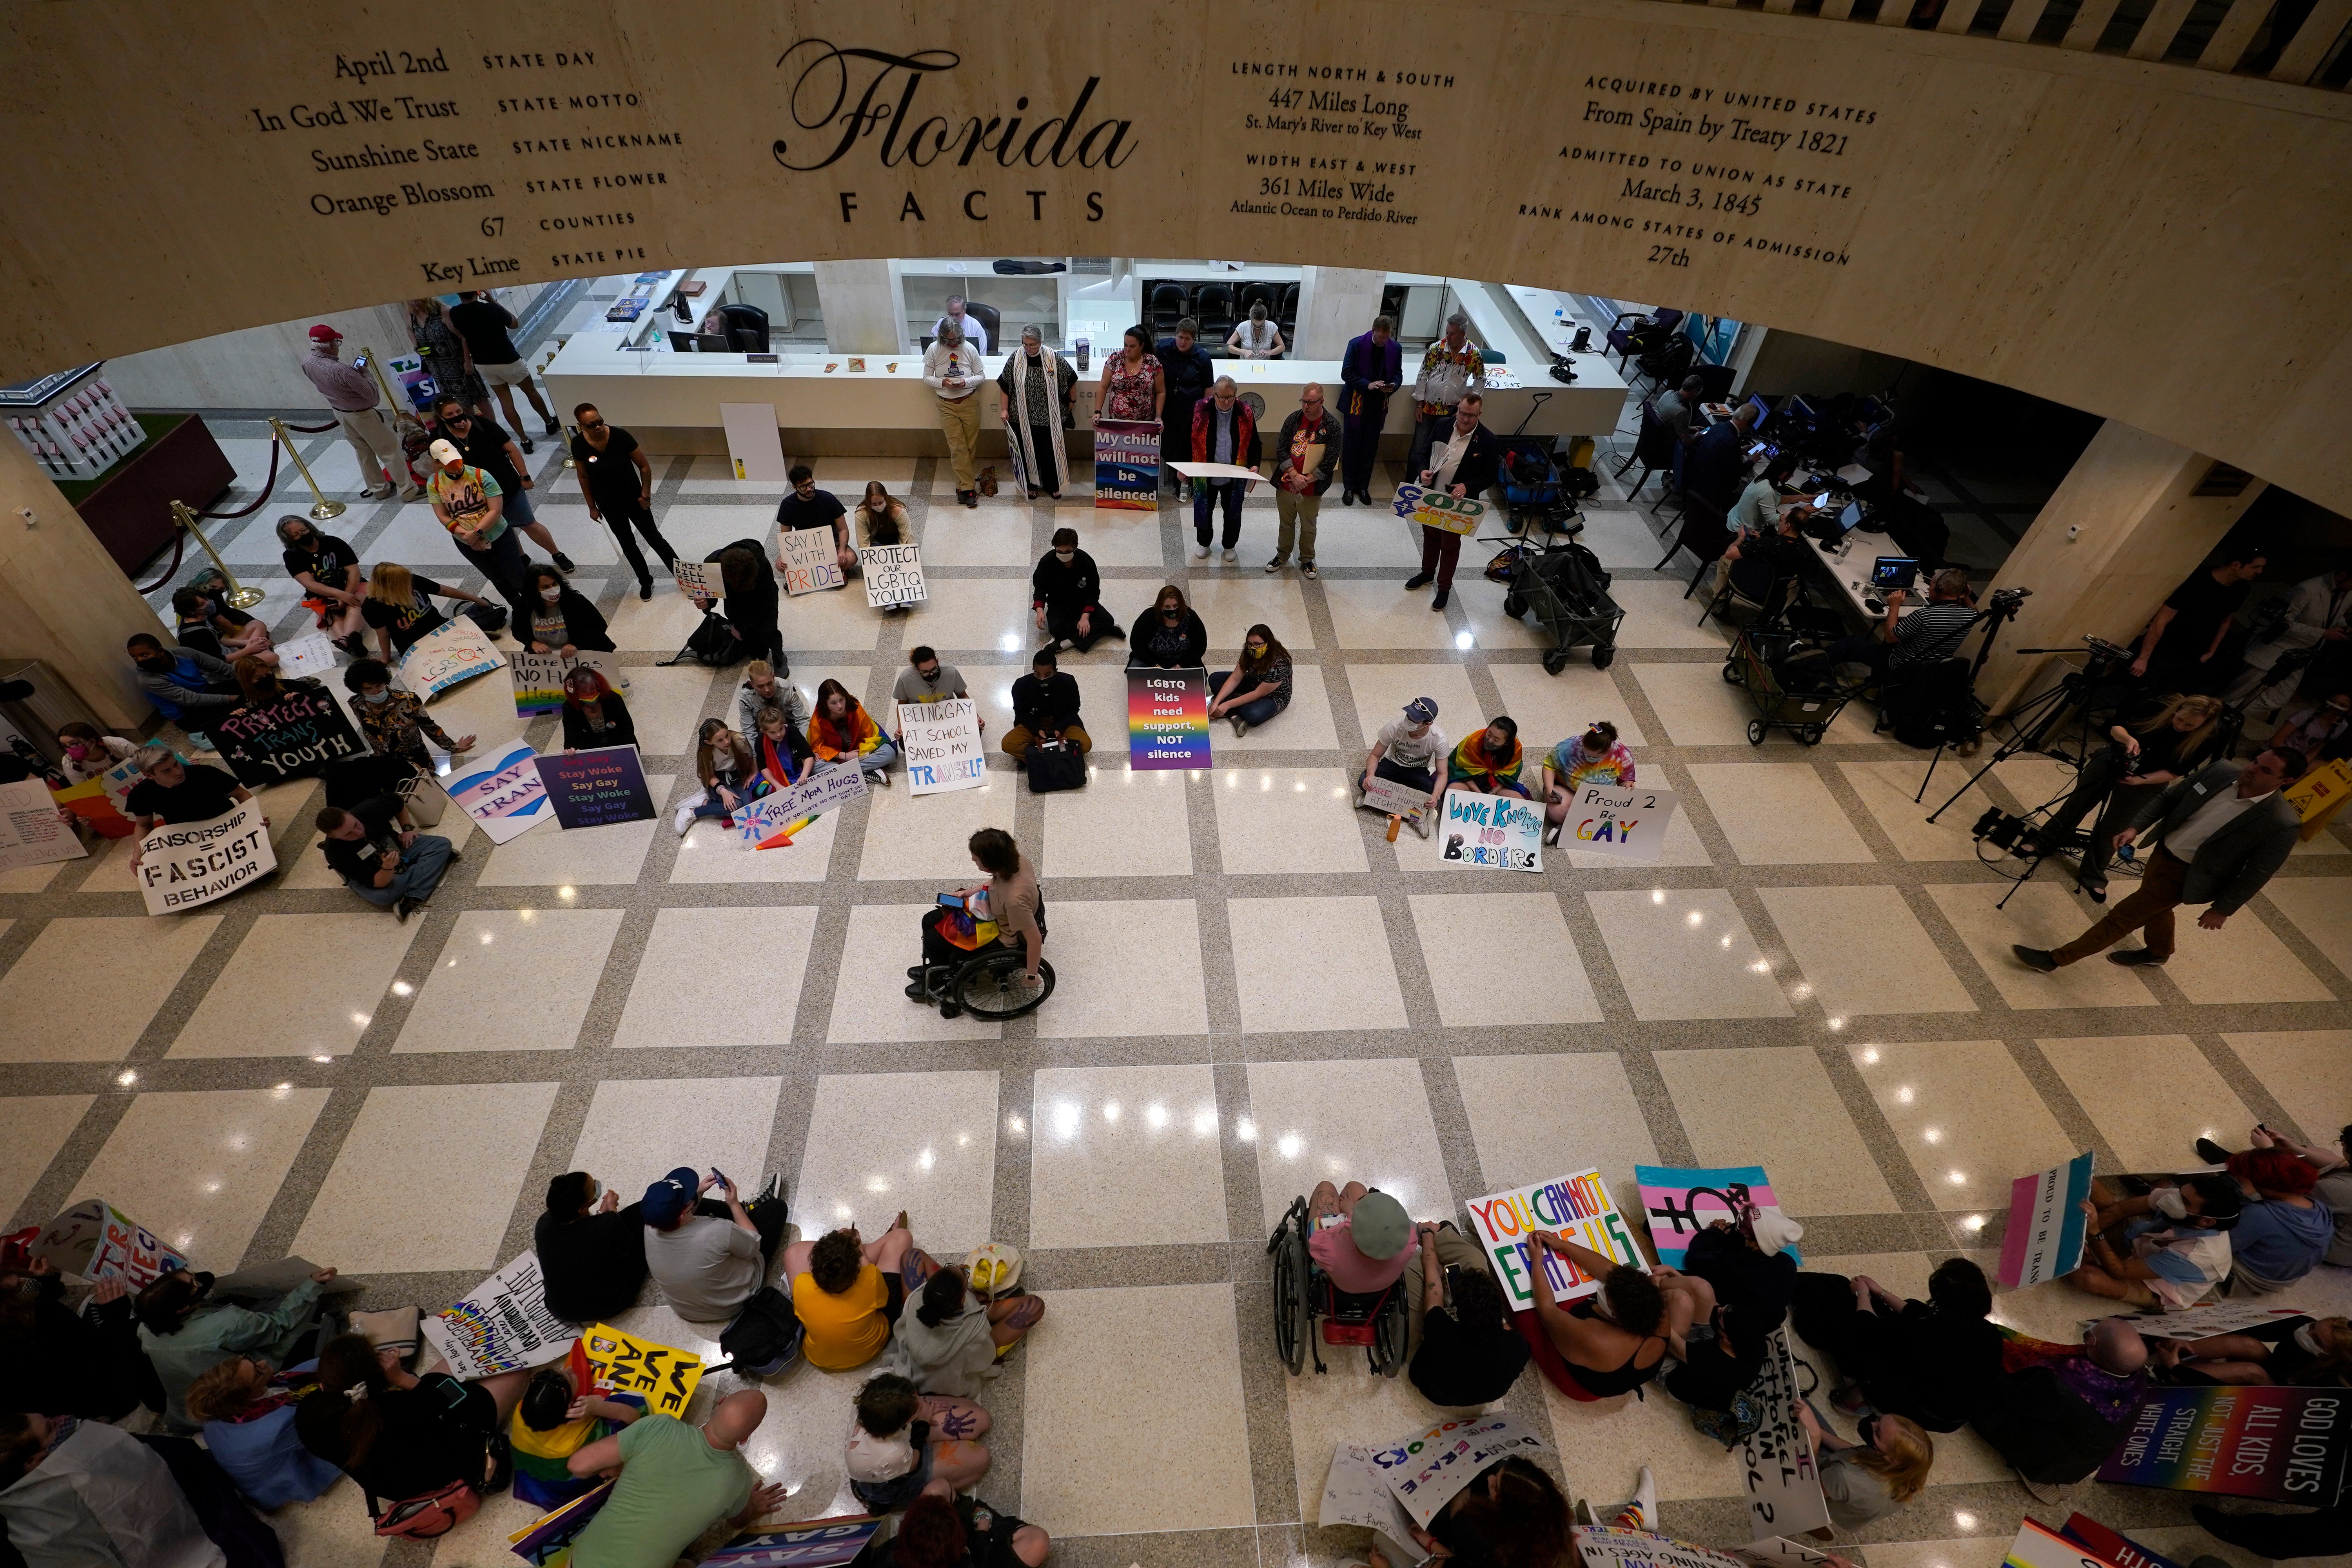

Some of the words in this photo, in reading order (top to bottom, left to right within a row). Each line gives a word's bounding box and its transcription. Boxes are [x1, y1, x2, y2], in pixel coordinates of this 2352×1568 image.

[336, 50, 396, 86] April
[402, 47, 450, 73] 2nd
[483, 54, 545, 69] STATE
[555, 52, 593, 66] DAY
[1232, 62, 1298, 77] LENGTH
[1308, 66, 1366, 81] NORTH
[1376, 71, 1385, 82] &
[1396, 72, 1454, 87] SOUTH
[498, 98, 558, 113] STATE
[569, 94, 638, 108] MOTTO
[773, 38, 1139, 171] Florida
[1269, 87, 1303, 110] 447
[1308, 91, 1357, 112] Miles
[1362, 93, 1409, 123] Long
[1584, 76, 1681, 97] ACQUIRED
[1689, 87, 1714, 102] BY
[1724, 92, 1796, 112] UNITED
[1806, 103, 1877, 124] STATES
[251, 109, 287, 132] In
[290, 101, 348, 128] God
[347, 99, 393, 122] We
[394, 96, 459, 119] Trust
[1246, 114, 1261, 129] St.
[1266, 115, 1307, 134] Mary's
[1310, 118, 1343, 133] River
[1347, 124, 1359, 134] to
[1363, 122, 1388, 140] Key
[1392, 123, 1422, 139] West
[1583, 101, 1633, 126] From
[1640, 107, 1692, 136] Spain
[1698, 114, 1724, 143] by
[1731, 118, 1792, 152] Treaty
[1797, 130, 1848, 155] 1821
[513, 139, 571, 154] STATE
[581, 133, 682, 149] NICKNAME
[311, 144, 419, 172] Sunshine
[423, 140, 479, 161] State
[1247, 154, 1300, 167] WIDTH
[1310, 158, 1348, 170] EAST
[1356, 161, 1365, 171] &
[1376, 162, 1416, 175] WEST
[526, 178, 583, 193] STATE
[593, 173, 667, 188] FLOWER
[1559, 147, 1649, 167] ADMITTED
[1661, 158, 1682, 172] TO
[1692, 163, 1754, 182] UNION
[1762, 174, 1785, 187] AS
[1794, 179, 1851, 198] STATE
[310, 194, 399, 216] Orange
[400, 182, 495, 205] Blossom
[1259, 177, 1289, 195] 361
[1297, 179, 1343, 199] Miles
[1349, 180, 1394, 203] Wide
[1621, 178, 1681, 203] March
[1686, 188, 1703, 210] 3,
[1712, 192, 1762, 216] 1845
[839, 190, 1103, 223] FACTS
[1230, 200, 1277, 214] Atlantic
[1281, 202, 1318, 217] Ocean
[1322, 209, 1334, 218] to
[1337, 206, 1382, 221] Perdido
[1386, 210, 1418, 224] River
[481, 217, 504, 237] 67
[540, 212, 634, 230] COUNTIES
[1519, 204, 1563, 219] RANK
[1570, 211, 1634, 229] AMONG
[1643, 221, 1704, 239] STATES
[1713, 232, 1736, 244] OF
[1743, 237, 1849, 265] ADMISSION
[552, 251, 605, 266] STATE
[615, 248, 645, 260] PIE
[1647, 245, 1689, 267] 27th
[421, 263, 463, 283] Key
[467, 256, 520, 276] Lime
[1096, 432, 1119, 447] My
[1123, 434, 1160, 446] child
[1099, 451, 1126, 463] will
[1131, 454, 1156, 464] not
[1118, 470, 1136, 481] be
[1096, 488, 1157, 501] silenced
[784, 535, 808, 552] SAY
[813, 531, 824, 546] IT
[791, 550, 825, 566] WITH
[862, 546, 918, 565] PROTECT
[787, 563, 843, 591] PRIDE
[883, 564, 901, 573] OUR
[868, 571, 921, 591] LGBTQ
[871, 586, 924, 605] YOUTH
[1147, 679, 1186, 690] LGBTQ
[1155, 693, 1180, 702] kids
[220, 695, 316, 740] PROTECT
[902, 704, 944, 722] BEING
[945, 702, 973, 719] GAY
[1153, 707, 1183, 715] need
[254, 720, 318, 751] TRANS
[905, 729, 921, 742] AT
[927, 725, 972, 741] SCHOOL
[1143, 721, 1195, 732] support,
[908, 746, 945, 761] SAVED
[951, 742, 968, 755] MY
[1157, 735, 1183, 744] NOT
[261, 733, 352, 775] YOUTH
[1148, 749, 1192, 759] silence
[480, 766, 521, 796] SAY
[559, 770, 586, 780] Stay
[587, 766, 623, 775] Woke
[909, 757, 983, 786] TRANSELF
[568, 793, 595, 803] Stay
[597, 789, 631, 799] Woke
[572, 781, 593, 791] Say
[595, 779, 619, 788] Gay
[765, 798, 797, 821] FREE
[801, 786, 823, 802] MOM
[828, 773, 859, 792] HUGS
[1374, 778, 1404, 794] TRANS
[1370, 795, 1404, 813] RIGHTS
[1372, 786, 1391, 797] ARE
[1397, 796, 1425, 810] HUMAN
[1584, 789, 1634, 808] Proud
[1643, 796, 1655, 809] 2
[1450, 793, 1490, 826] LOVE
[1492, 798, 1543, 837] KNOWS
[1599, 810, 1616, 820] Be
[142, 811, 246, 857] CENSORSHIP
[1478, 828, 1505, 845] NO
[1577, 819, 1639, 843] GAY
[144, 830, 259, 887] FASCIST
[1444, 833, 1536, 869] BORDERS
[163, 861, 258, 907] BEHAVIOR
[2045, 1169, 2057, 1203] PROUD
[1470, 1194, 1535, 1242] YOU
[1532, 1172, 1610, 1226] CANNOT
[2042, 1207, 2051, 1223] TO
[1583, 1212, 1641, 1269] US
[2037, 1229, 2047, 1244] BE
[2029, 1250, 2043, 1284] TRANS
[2133, 1402, 2166, 1434] WHITE
[2208, 1396, 2237, 1420] NOT
[2244, 1404, 2283, 1431] ALL
[2299, 1397, 2341, 1430] GOD
[1463, 1422, 1506, 1437] OUR
[2195, 1422, 2226, 1454] JUST
[1372, 1419, 1477, 1470] COLORS
[1474, 1436, 1542, 1464] DONT
[2120, 1435, 2150, 1467] ONES
[2228, 1436, 2273, 1476] KIDS,
[1400, 1439, 1471, 1495] ERASE
[2185, 1457, 2216, 1481] THE
[2283, 1434, 2330, 1494] LOVES
